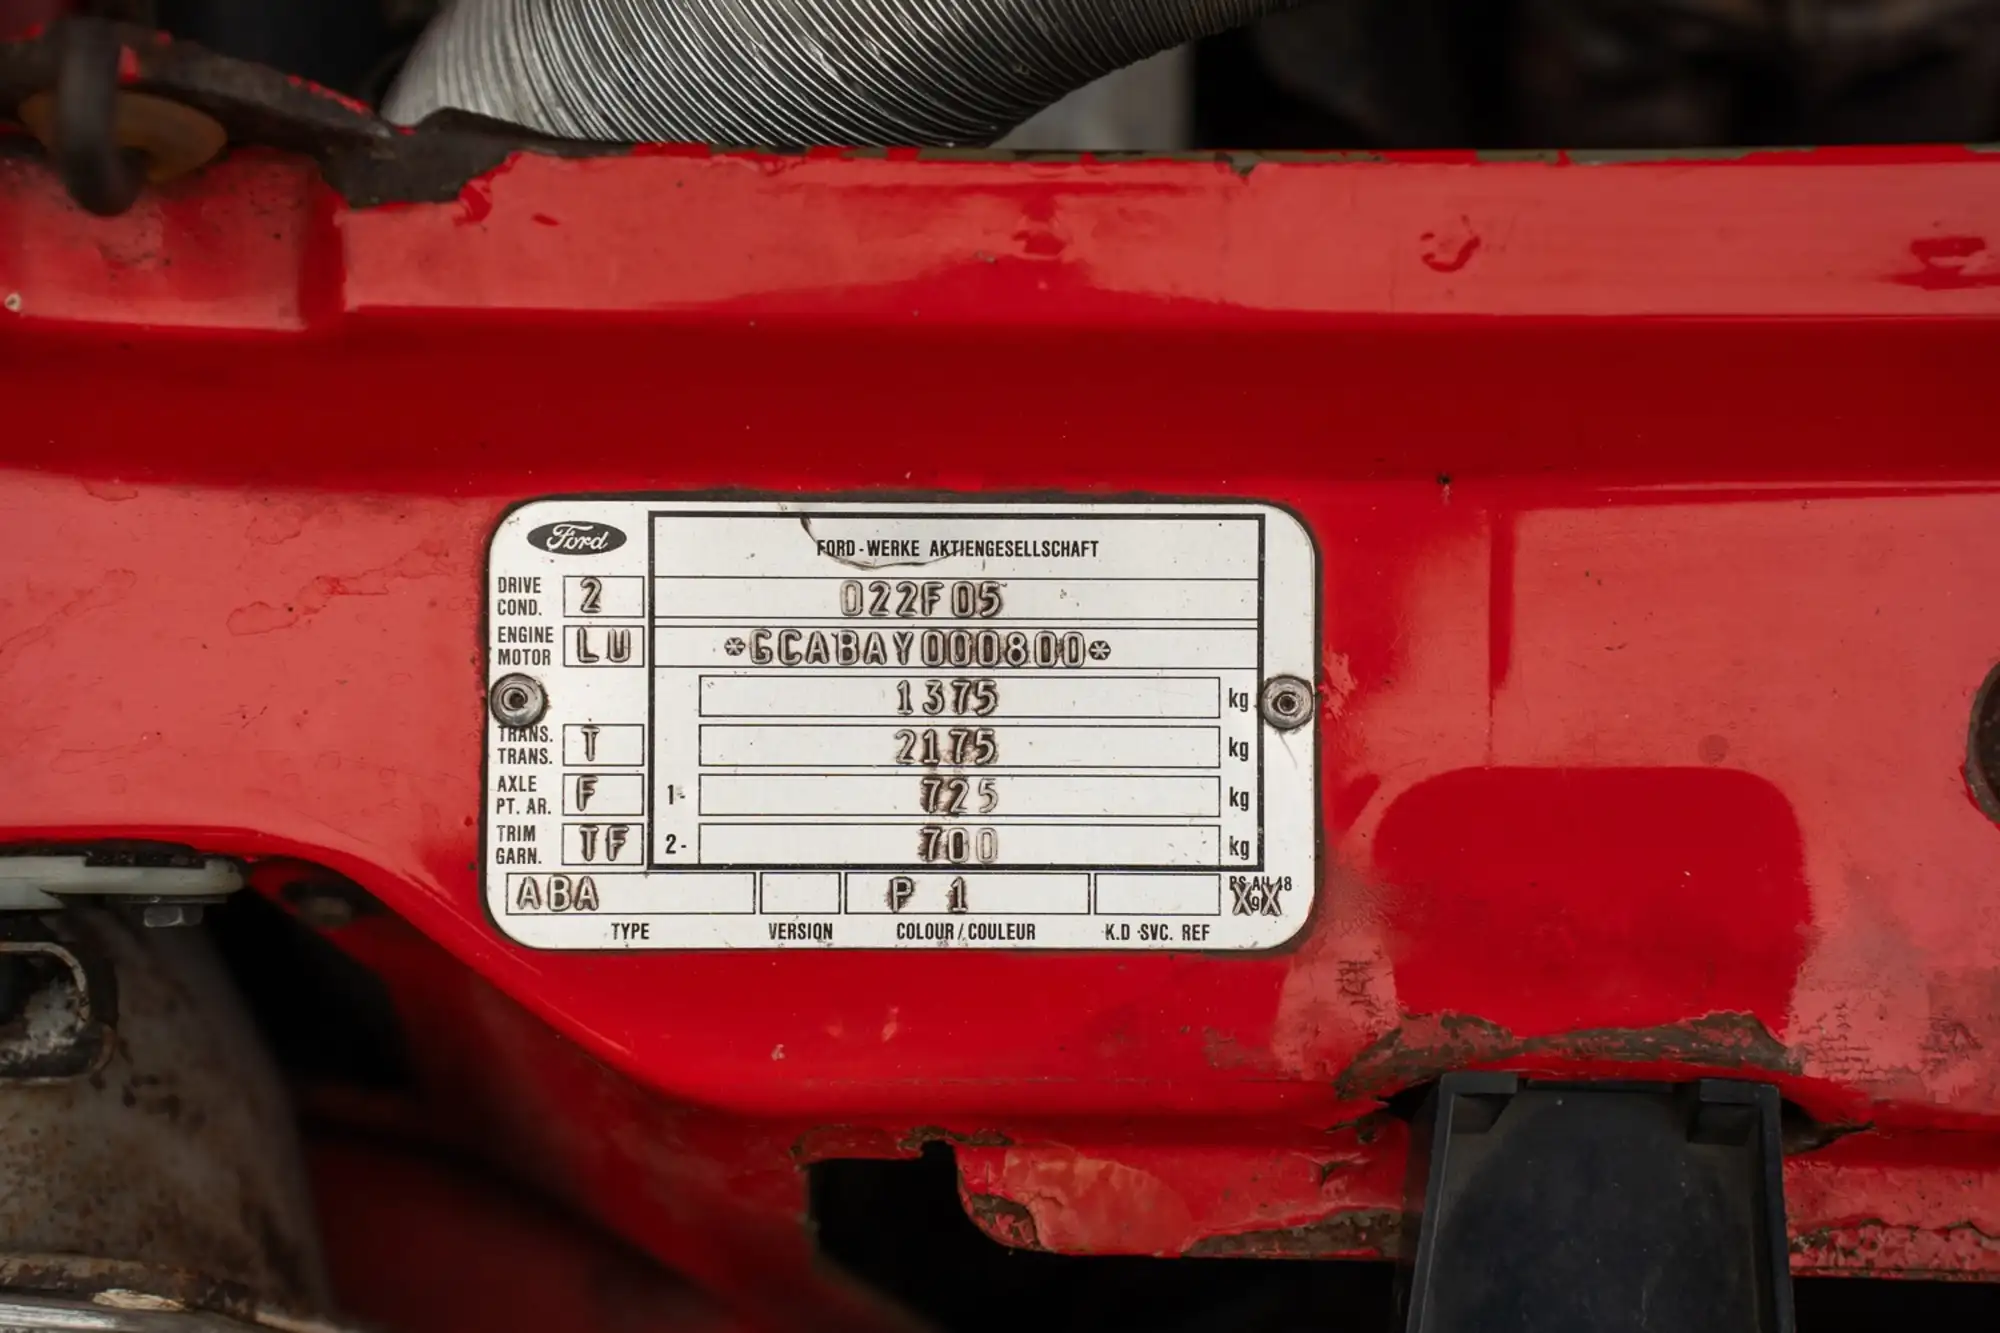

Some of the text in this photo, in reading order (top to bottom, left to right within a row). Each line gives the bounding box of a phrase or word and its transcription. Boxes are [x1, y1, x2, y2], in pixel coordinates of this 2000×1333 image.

[546, 525, 608, 551] Ford
[817, 540, 855, 556] FORD
[867, 540, 920, 557] WERKE
[929, 540, 1099, 557] AKTIENGESELLSCHAFT
[498, 577, 541, 593] DRIVE
[580, 577, 602, 613] 2
[498, 599, 542, 616] COND.
[840, 580, 1003, 617] 022F05
[498, 627, 554, 643] ENGINE
[498, 649, 551, 666] MOTOR
[897, 679, 999, 716] 1375
[1229, 687, 1249, 711] kg
[498, 725, 553, 742] TRANS.
[581, 725, 600, 761] T
[498, 748, 553, 764] TRANS.
[895, 729, 997, 765] 2175
[1229, 737, 1249, 761] kg
[497, 775, 537, 792] AXLE
[576, 775, 598, 811] F
[496, 798, 551, 815] PT. AR.
[921, 779, 998, 814] 725
[1229, 787, 1250, 811] kg
[497, 825, 536, 842] TRIM
[496, 847, 542, 865] GARN.
[921, 828, 998, 864] 700
[1229, 837, 1250, 861] kg
[517, 875, 600, 912] ABA
[890, 876, 968, 913] P 1
[611, 923, 650, 940] TYPE
[768, 923, 833, 941] VERSION
[896, 922, 954, 940] COLOUR
[968, 923, 1036, 940] COULEUR
[1105, 923, 1210, 941] K.D SVC. REF
